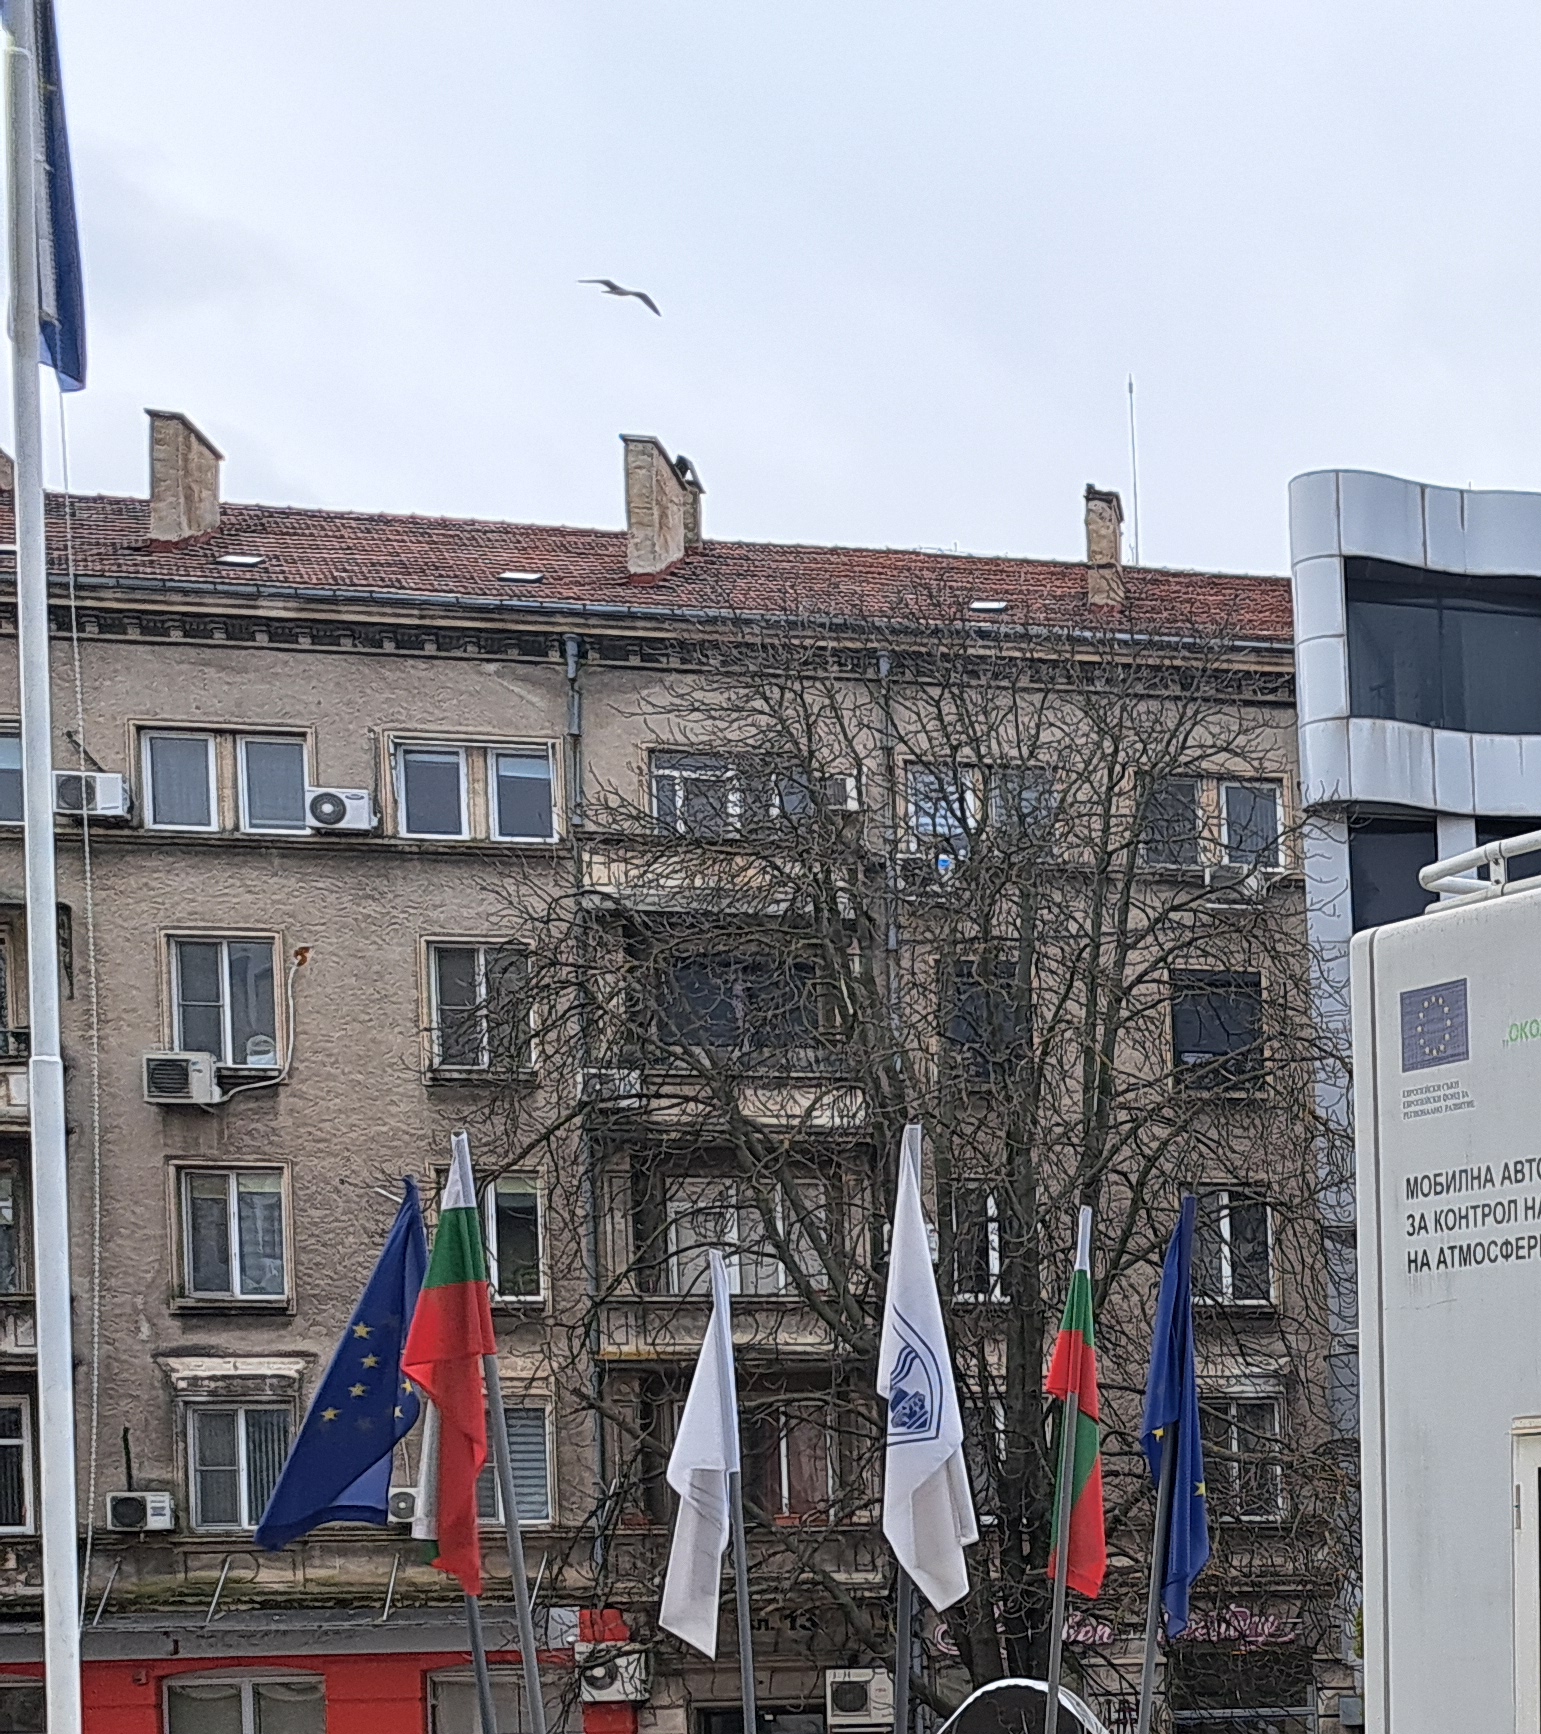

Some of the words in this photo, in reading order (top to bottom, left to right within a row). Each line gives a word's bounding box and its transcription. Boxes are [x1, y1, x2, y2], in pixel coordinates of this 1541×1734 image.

[1406, 1165, 1495, 1200] МОБИЛНА
[1406, 1213, 1428, 1237] ЗА
[1434, 1199, 1518, 1232] КОНТРОЛ
[1407, 1249, 1431, 1274] НА
